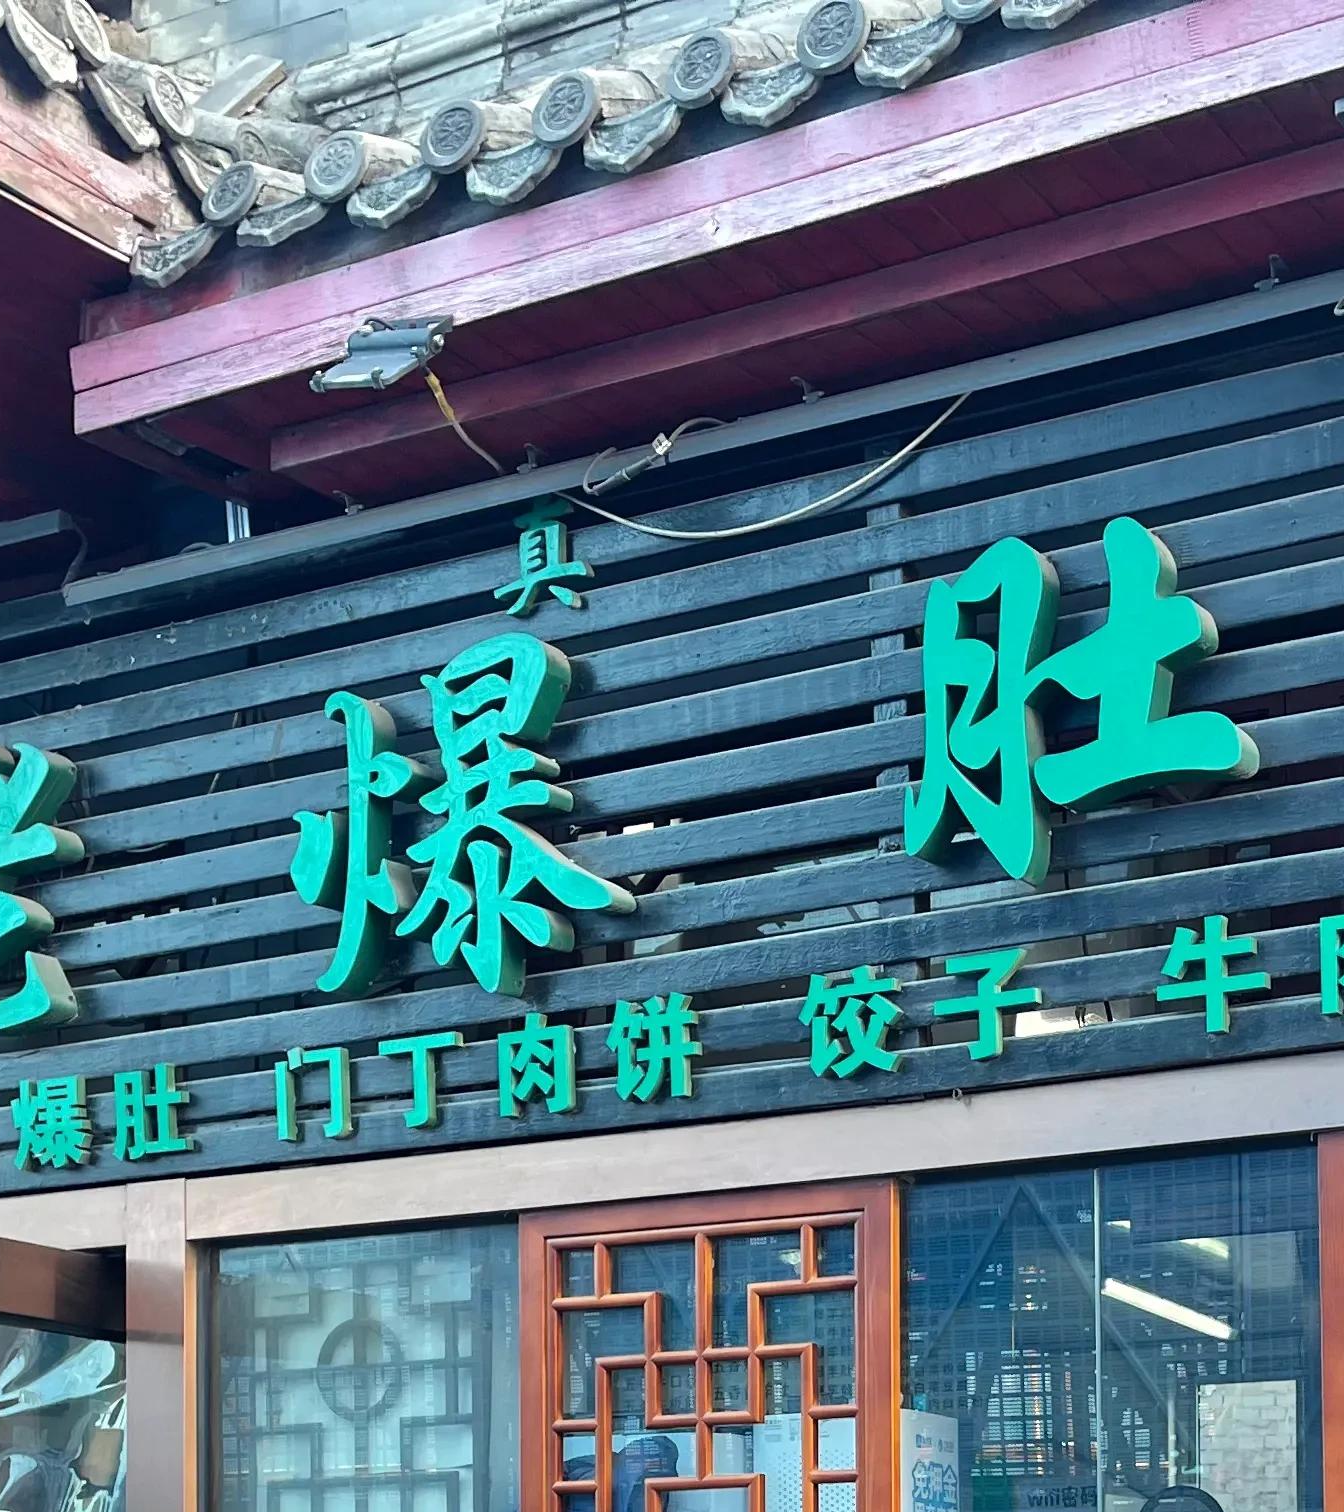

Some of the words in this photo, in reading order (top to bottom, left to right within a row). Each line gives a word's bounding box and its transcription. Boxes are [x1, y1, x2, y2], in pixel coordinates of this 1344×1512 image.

[12, 1063, 196, 1170] 爆肚
[275, 992, 701, 1142] 门丁肉饼
[798, 948, 1042, 1079] 饺子
[912, 1461, 958, 1504] 免押金
